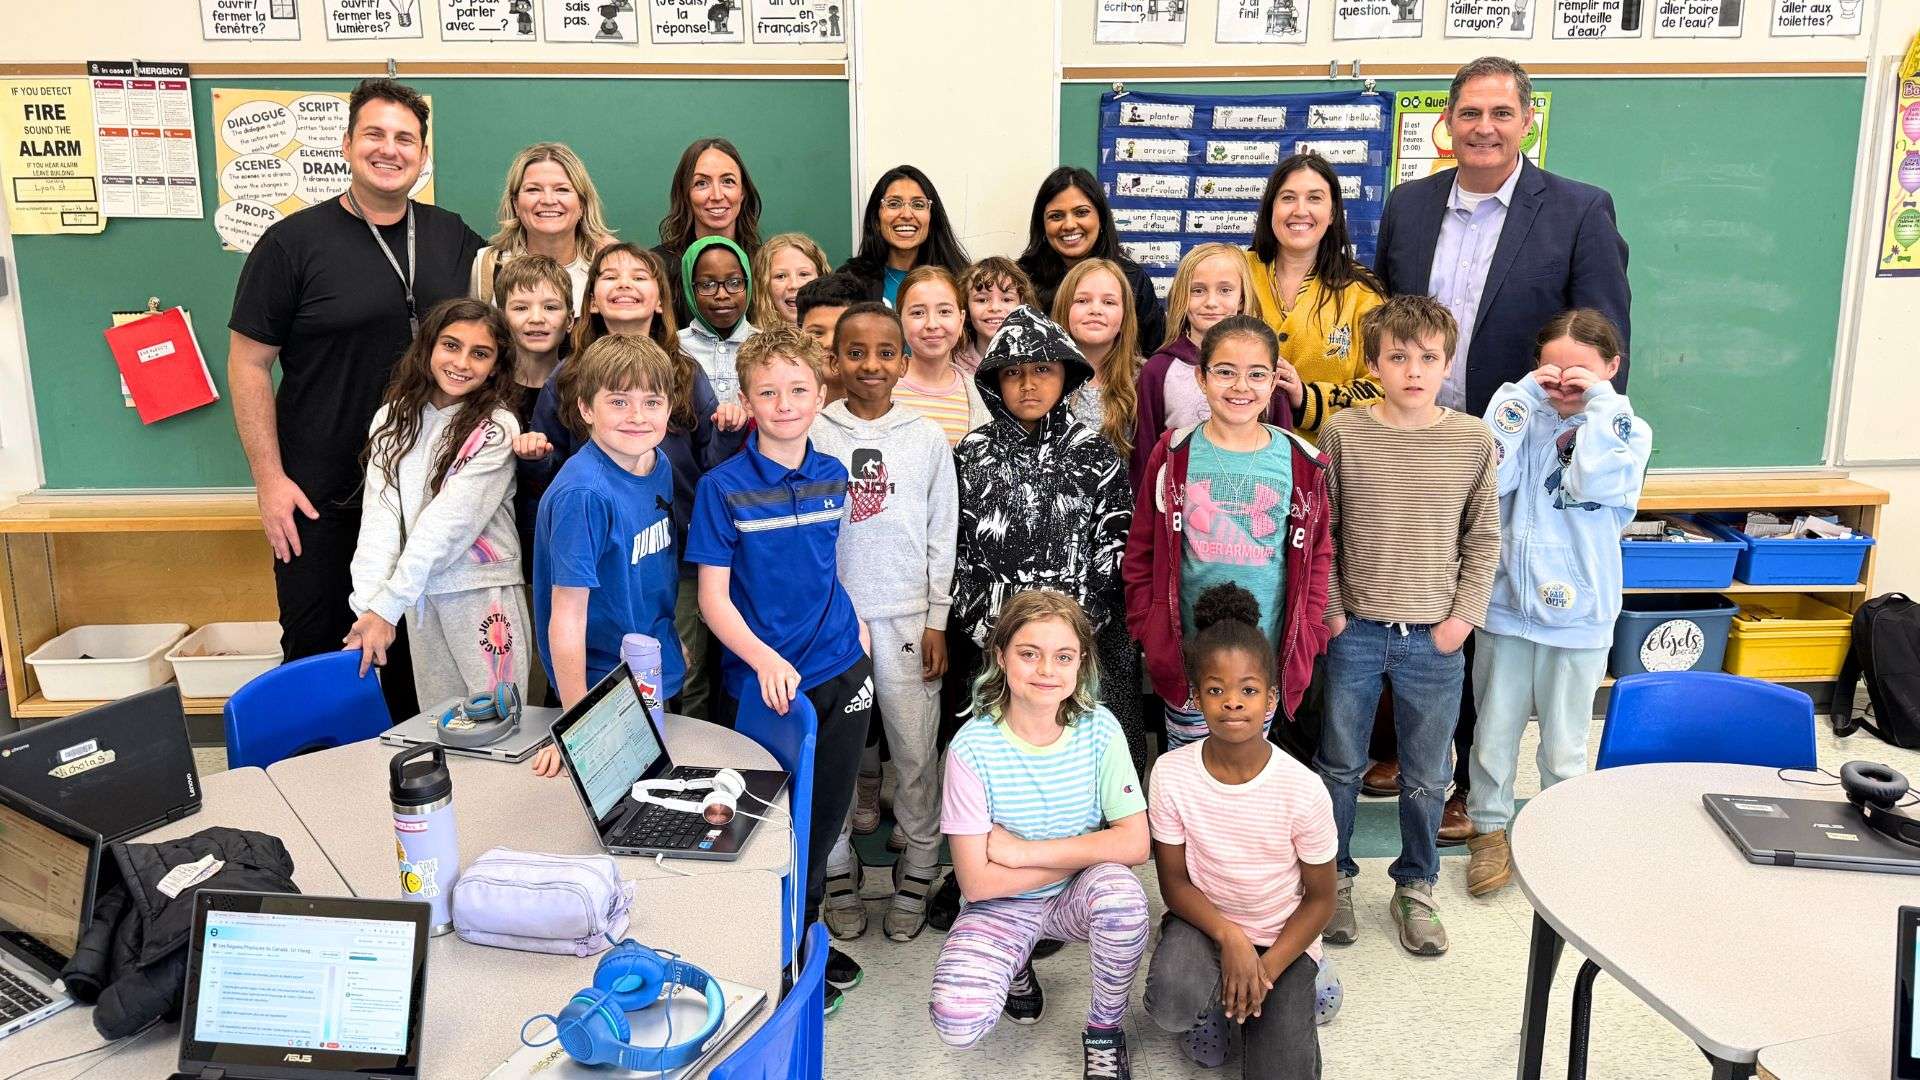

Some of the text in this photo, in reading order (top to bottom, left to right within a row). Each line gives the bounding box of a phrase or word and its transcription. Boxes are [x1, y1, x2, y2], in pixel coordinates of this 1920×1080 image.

[566, 1, 590, 12] sais
[1104, 0, 1143, 12] écrit-on
[1339, 4, 1391, 20] question.
[1450, 4, 1510, 16] tailler mon
[1558, 0, 1620, 12] remplir ma
[1660, 4, 1718, 14] aller boire
[1781, 2, 1832, 13] aller aux
[212, 11, 266, 22] fermer la
[333, 9, 392, 21] fermer les
[456, 6, 496, 20] parler
[677, 8, 688, 20] la
[800, 10, 815, 20] en
[1239, 8, 1260, 19] fini!
[1564, 12, 1612, 24] bouteille
[446, 22, 476, 30] avec
[564, 16, 590, 28] pas.
[1454, 16, 1504, 31] crayon?
[1661, 16, 1714, 28] de l'eau?
[1778, 14, 1834, 26] toilettes?
[214, 22, 266, 34] fenêtre?
[336, 20, 391, 34] lumières?
[656, 21, 711, 37] réponse!
[758, 20, 818, 36] français?
[1568, 25, 1606, 37] d'eau?
[12, 86, 72, 96] IF YOU DETECT
[24, 104, 66, 120] FIRE
[299, 102, 340, 112] SCRIPT
[227, 108, 286, 129] DIALOGUE
[1149, 112, 1180, 122] planter
[1256, 114, 1277, 122] fleur
[24, 126, 72, 134] SOUND THE
[243, 124, 266, 136] dialogue
[250, 135, 268, 143] actors
[20, 140, 82, 156] ALARM
[300, 150, 344, 158] ELEMENTS
[1230, 153, 1270, 162] grenouille
[234, 158, 282, 172] SCENES
[1136, 186, 1184, 195] cerf-volant
[1234, 184, 1261, 193] abeille
[236, 202, 276, 221] PROPS
[1150, 214, 1176, 223] flaque
[1226, 214, 1248, 224] jeune
[1142, 221, 1165, 230] d'eau
[1216, 222, 1241, 231] plante
[1140, 253, 1170, 262] graines
[631, 516, 672, 565] PUMA
[1192, 541, 1224, 554] NDER
[188, 772, 196, 798] Lenovo
[284, 1054, 312, 1062] ASUS
